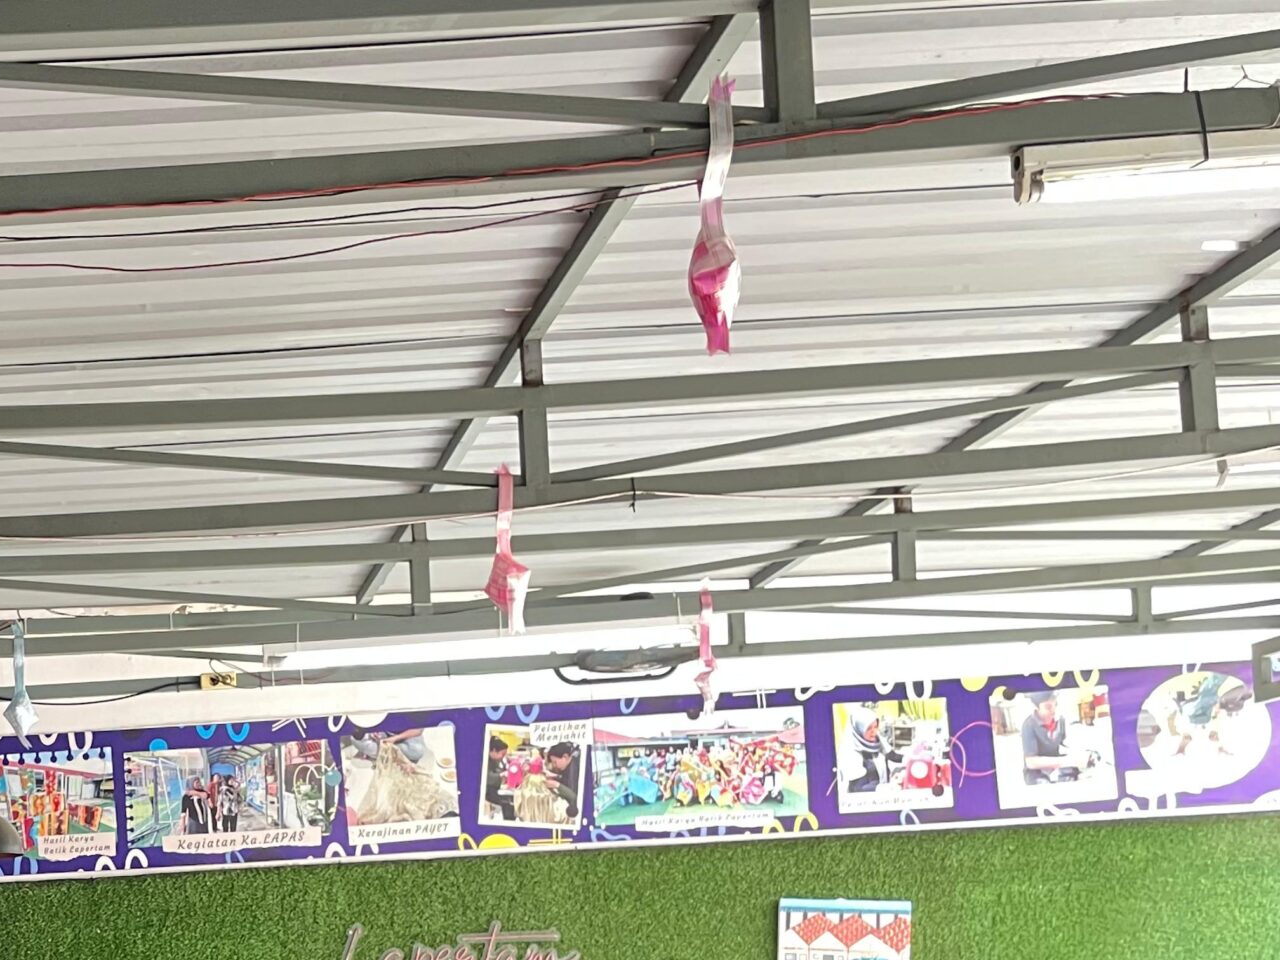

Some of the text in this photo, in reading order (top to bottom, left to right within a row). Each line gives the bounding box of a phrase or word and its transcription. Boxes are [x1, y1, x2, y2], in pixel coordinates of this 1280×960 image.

[358, 826, 412, 838] Kerajinan
[43, 835, 95, 844] Hasil Karya
[177, 830, 306, 852] Kegiatan Ka.LAPAS
[43, 846, 67, 855] Batik
